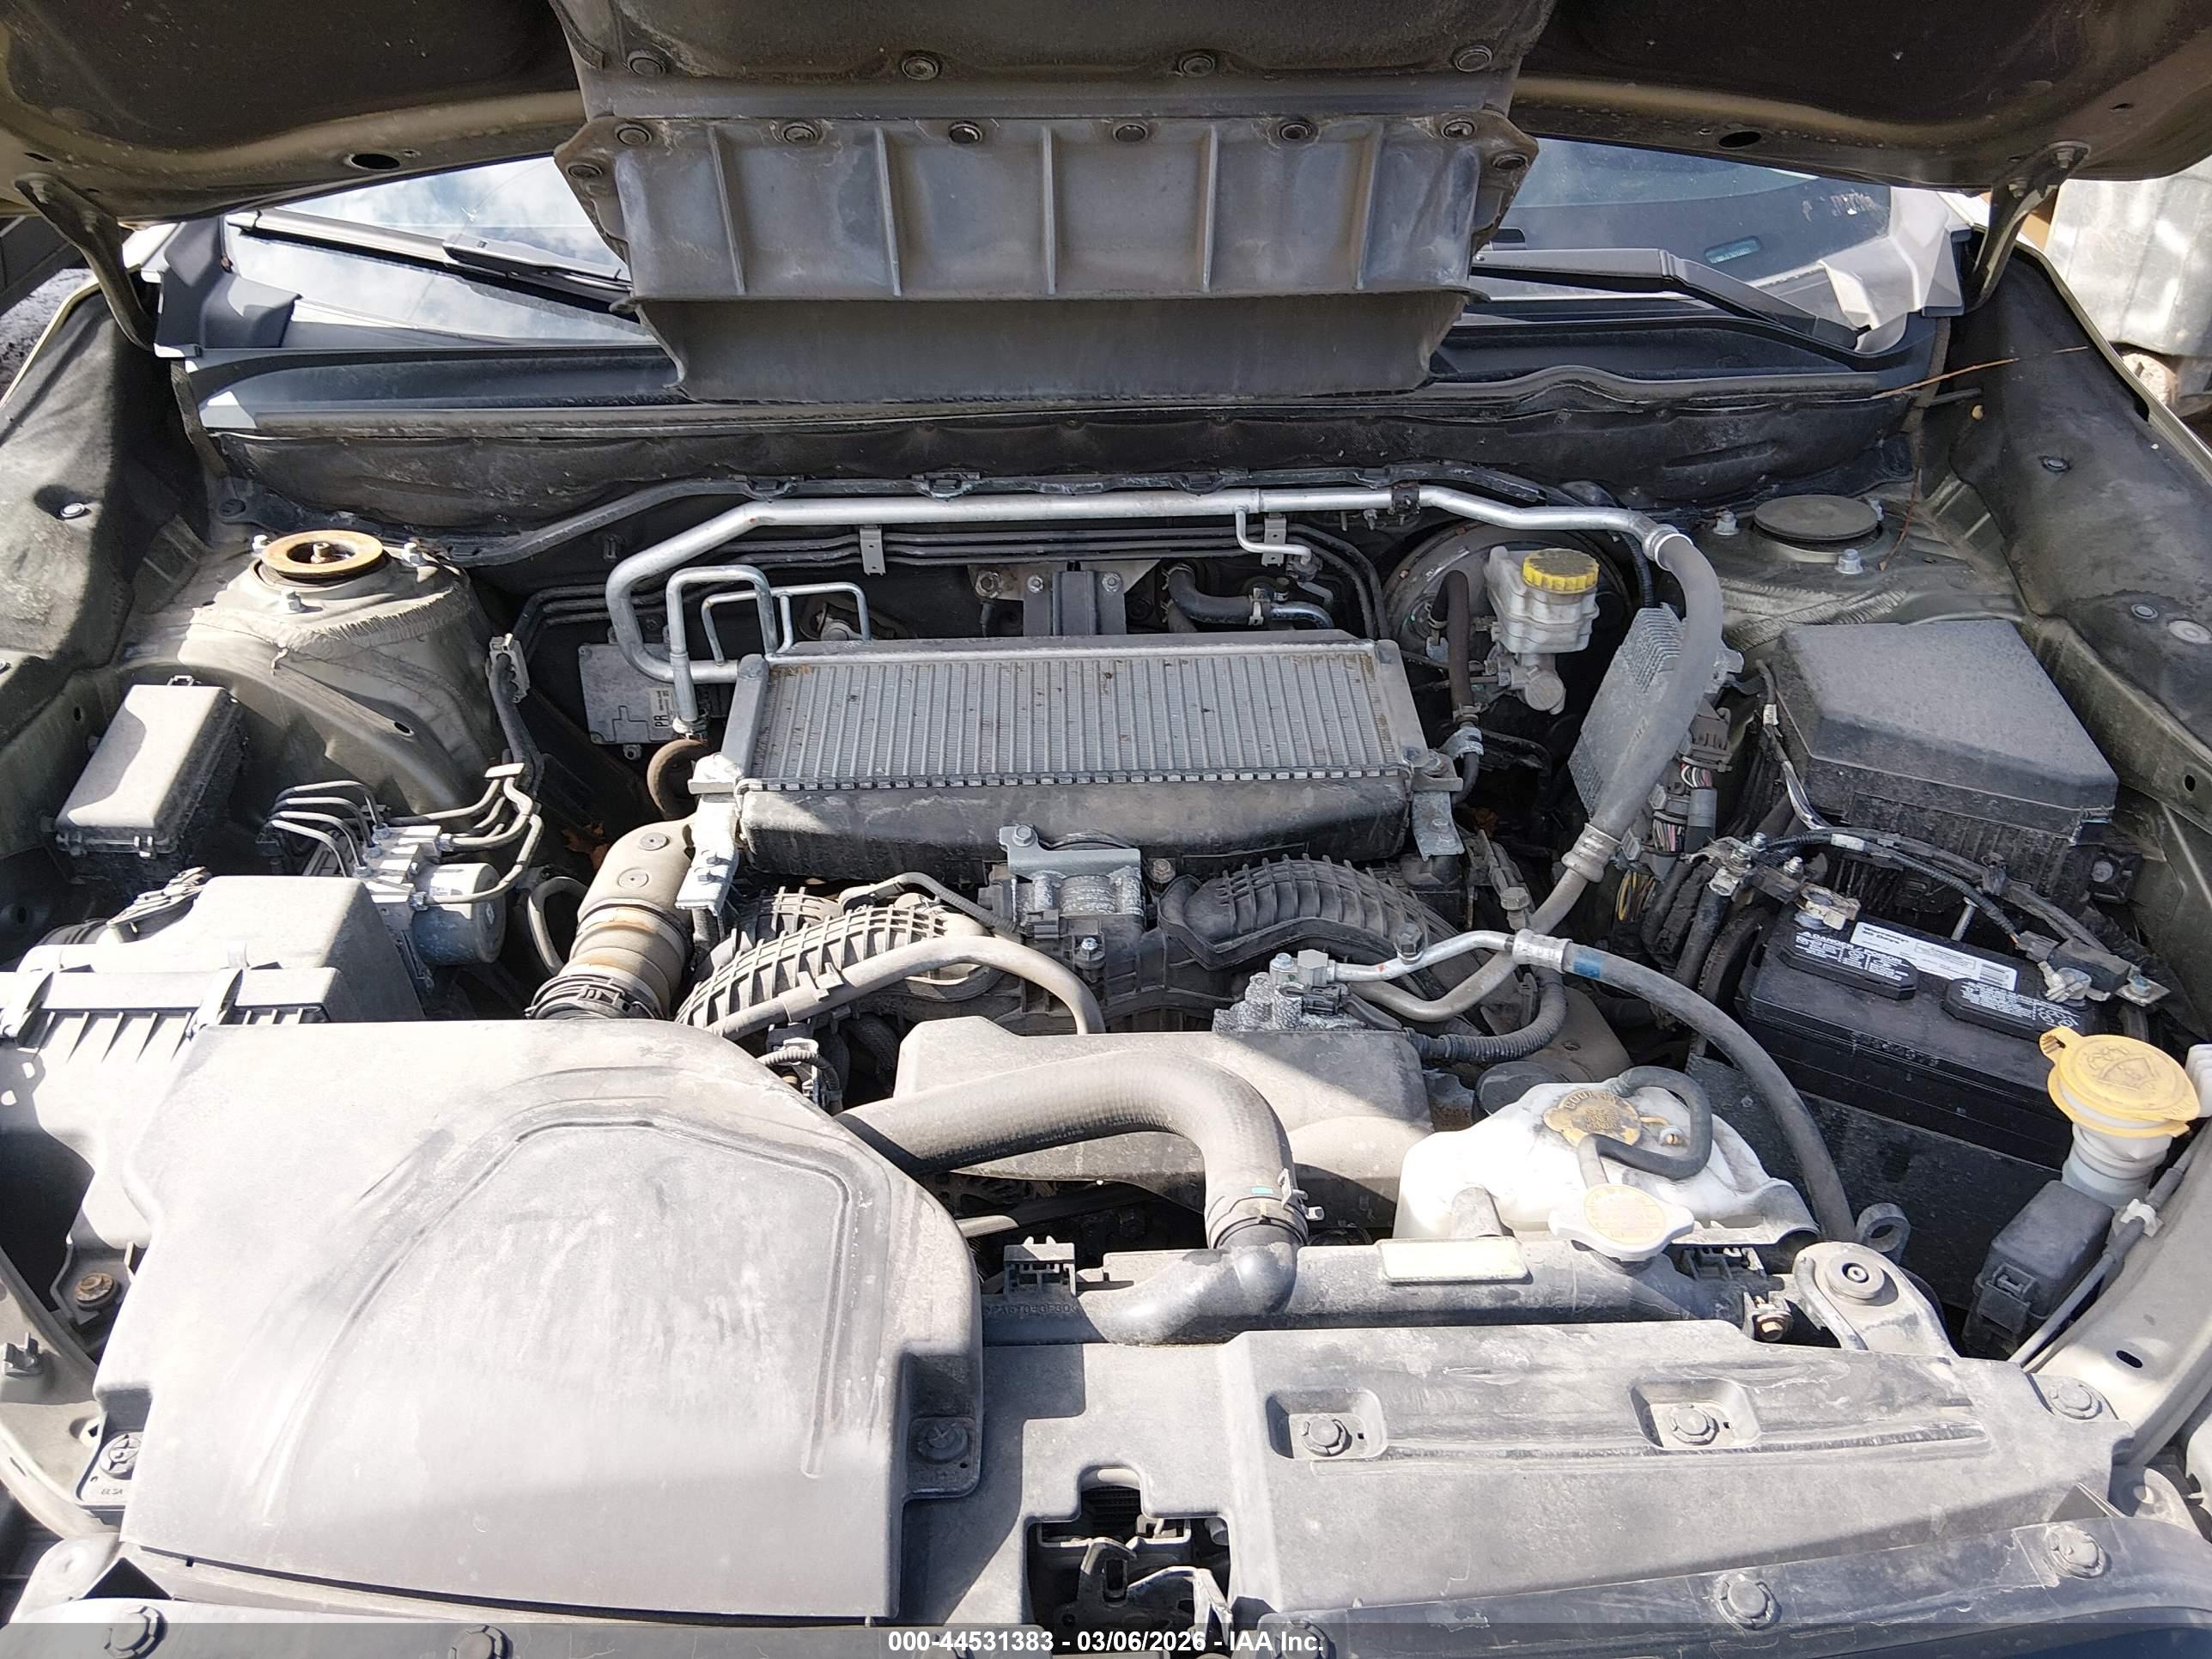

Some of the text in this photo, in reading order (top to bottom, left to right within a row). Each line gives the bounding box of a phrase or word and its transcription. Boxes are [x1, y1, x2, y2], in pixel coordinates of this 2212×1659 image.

[654, 714, 669, 727] PR
[1813, 933, 1854, 949] DANGER
[1864, 949, 1902, 963] POISON
